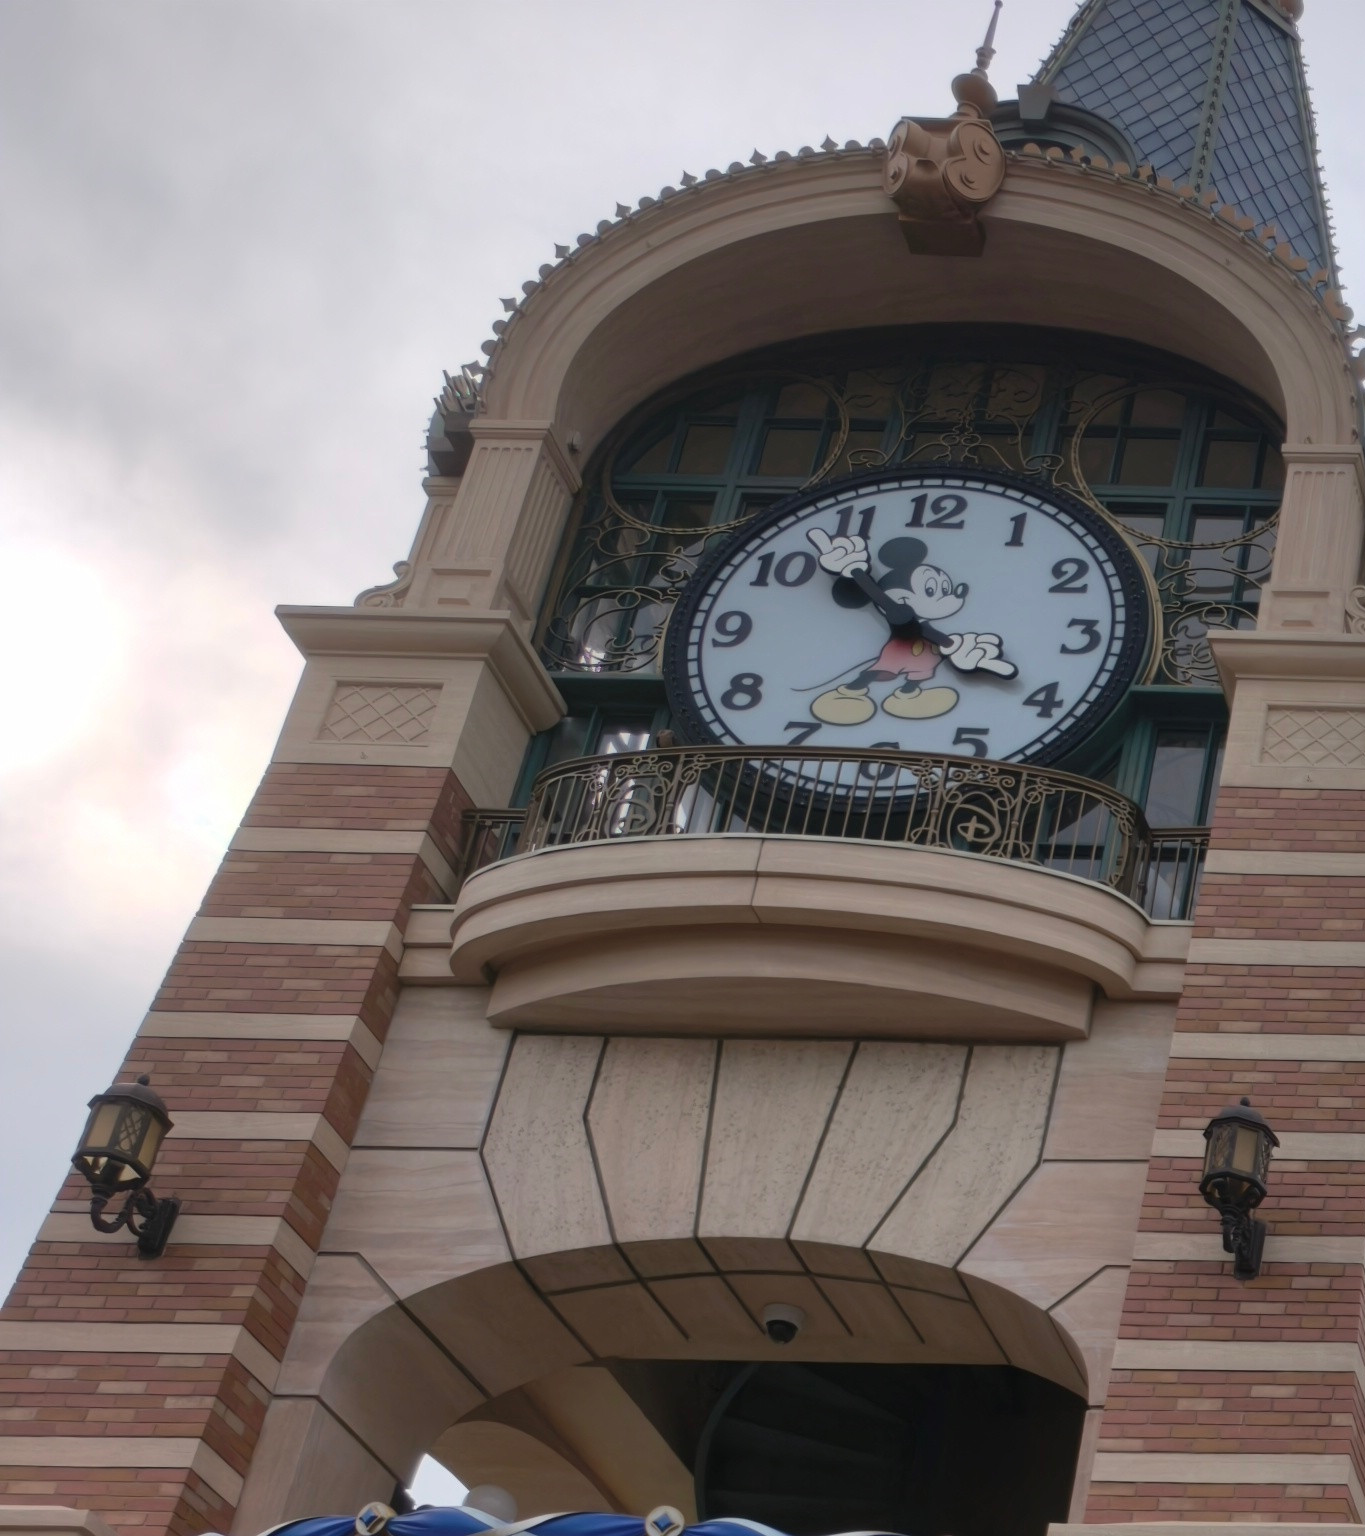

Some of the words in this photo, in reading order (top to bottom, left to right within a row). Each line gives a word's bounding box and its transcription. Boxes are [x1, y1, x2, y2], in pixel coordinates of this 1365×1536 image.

[835, 505, 877, 541] 11
[905, 494, 968, 530] 12
[1004, 512, 1028, 547] 1
[749, 550, 817, 588] 10
[1048, 558, 1090, 594] 2
[711, 610, 753, 648] 9
[1060, 618, 1102, 655] 3
[720, 672, 763, 711] 8
[1022, 681, 1064, 719] 4
[952, 727, 991, 759] 5
